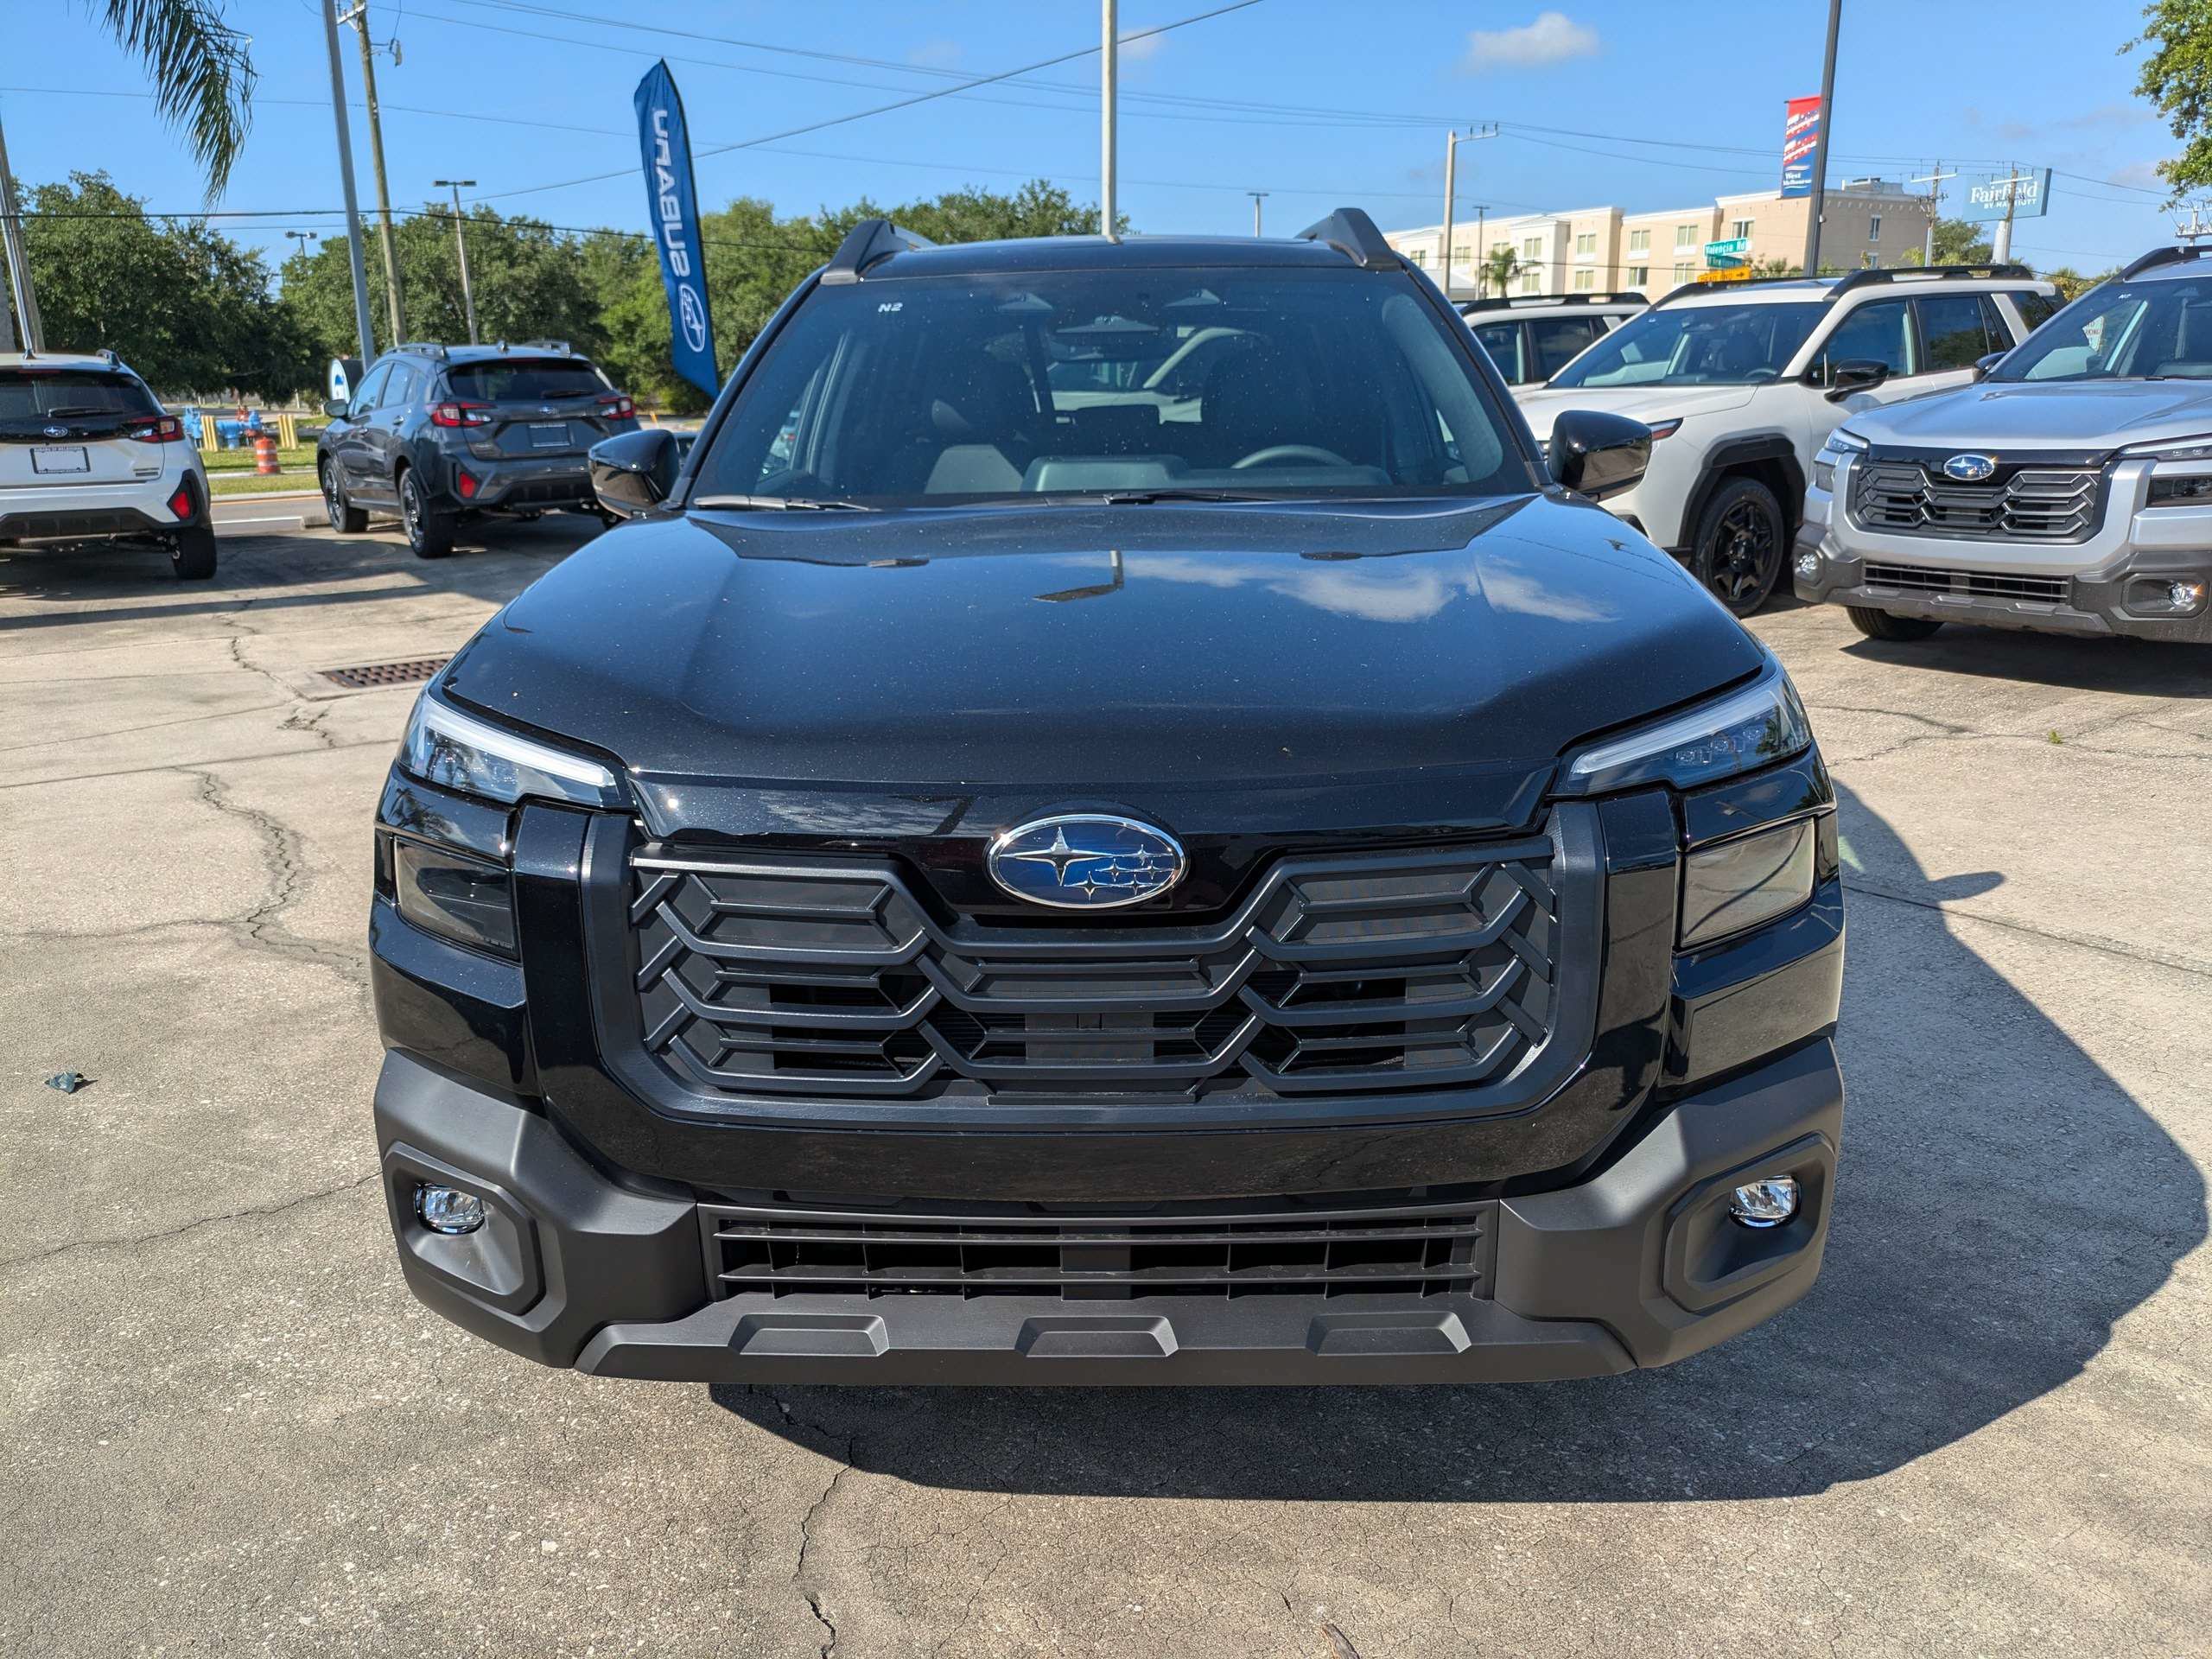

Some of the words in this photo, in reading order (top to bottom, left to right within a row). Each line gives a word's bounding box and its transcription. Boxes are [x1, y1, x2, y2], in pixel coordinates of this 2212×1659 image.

[1997, 199, 2037, 208] MAIOTT
[1705, 243, 1733, 255] Valencia
[1737, 239, 1745, 251] Rd
[878, 302, 904, 313] N2
